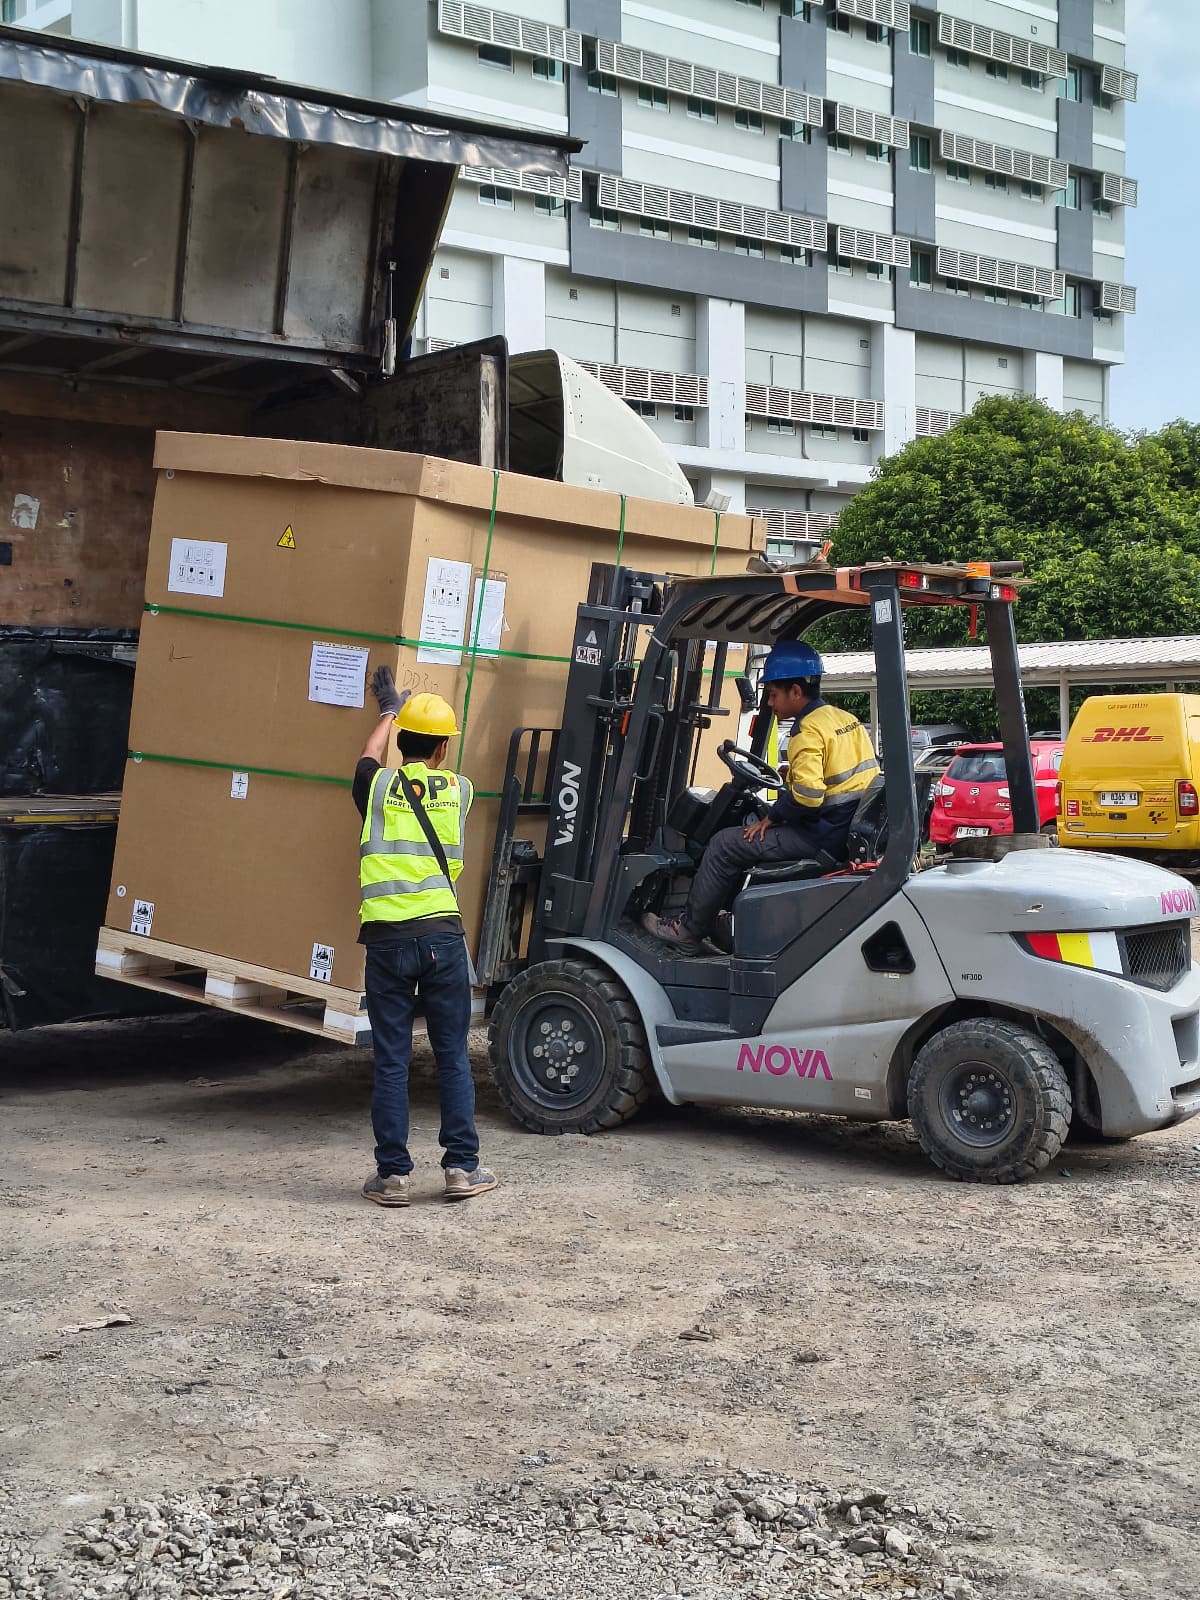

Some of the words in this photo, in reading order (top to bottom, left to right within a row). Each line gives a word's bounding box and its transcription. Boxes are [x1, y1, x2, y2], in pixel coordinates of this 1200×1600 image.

[1090, 727, 1153, 742] DHL
[1160, 888, 1197, 915] NOVA
[736, 1043, 833, 1081] NOVA
